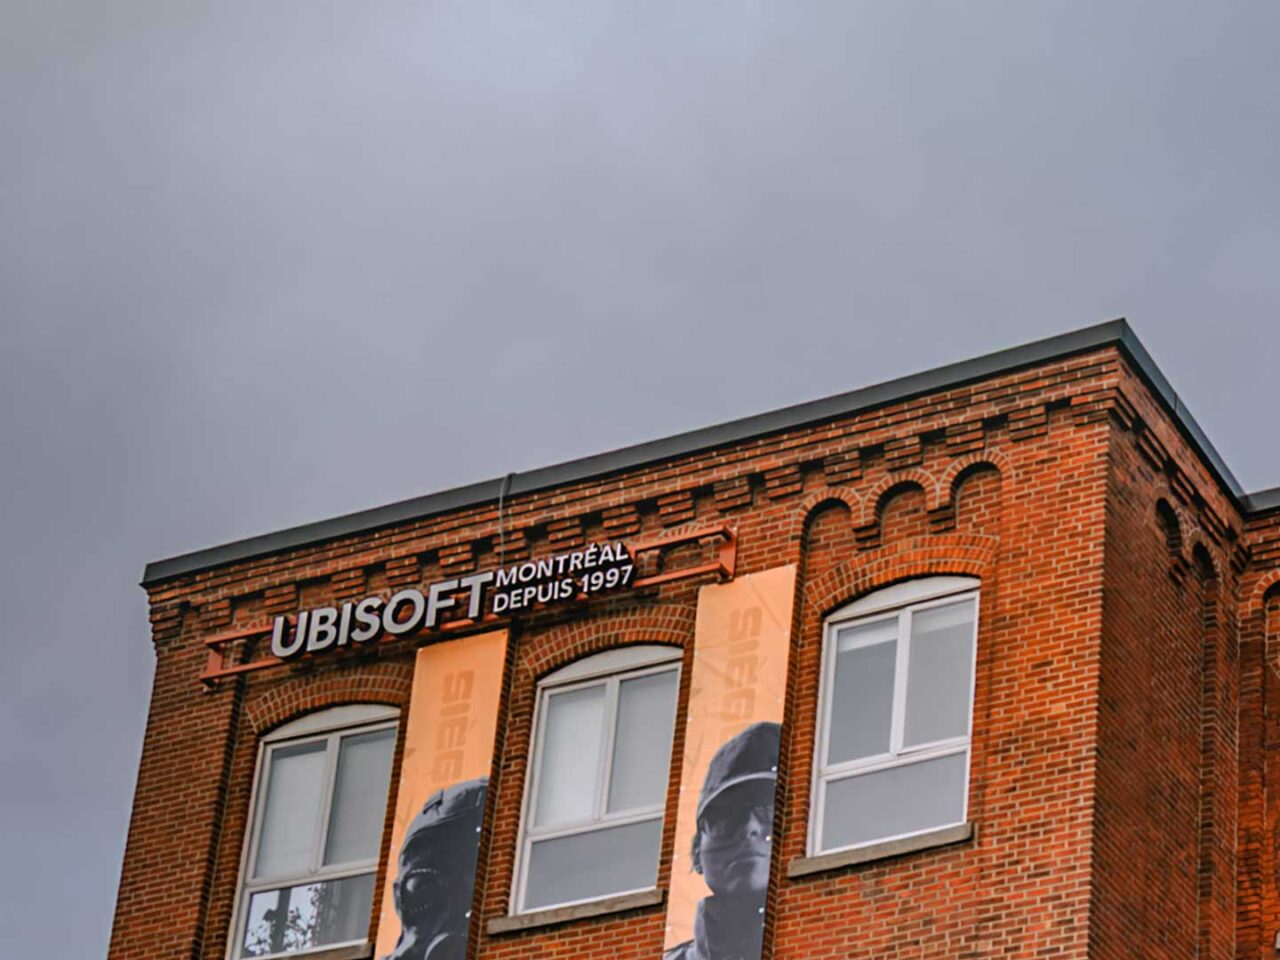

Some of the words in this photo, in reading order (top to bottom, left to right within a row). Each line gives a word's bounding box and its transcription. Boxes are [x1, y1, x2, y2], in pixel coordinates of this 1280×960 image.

[493, 578, 573, 612] DEPUIS
[581, 565, 633, 593] 1997
[495, 542, 629, 588] MONTRÉAL
[270, 571, 494, 658] UBISOFT
[720, 605, 768, 724] SIÈG
[431, 669, 478, 785] SIÈG
